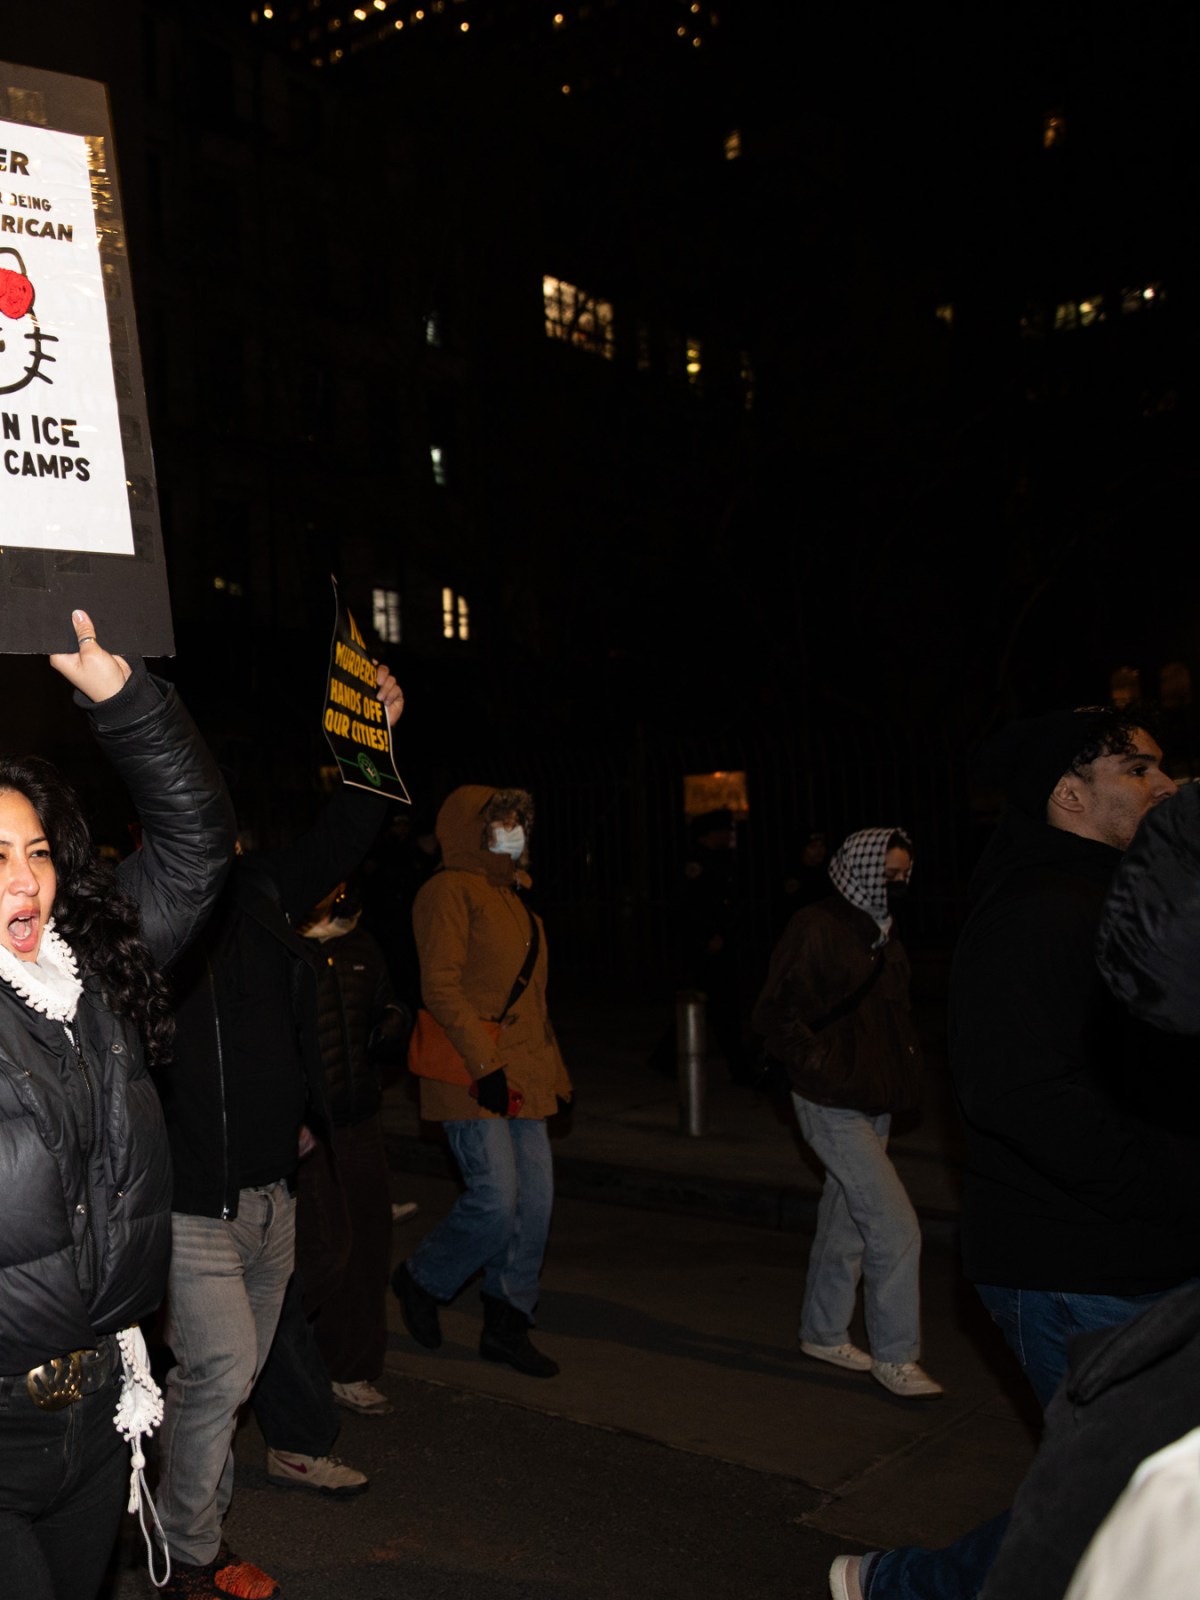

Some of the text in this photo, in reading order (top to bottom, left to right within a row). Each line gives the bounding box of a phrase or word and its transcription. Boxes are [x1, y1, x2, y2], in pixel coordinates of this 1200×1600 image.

[31, 415, 80, 448] ICE
[4, 450, 91, 482] CAMPS
[330, 677, 383, 723] HANDS OFF
[325, 707, 389, 752] OUR CITIES!
